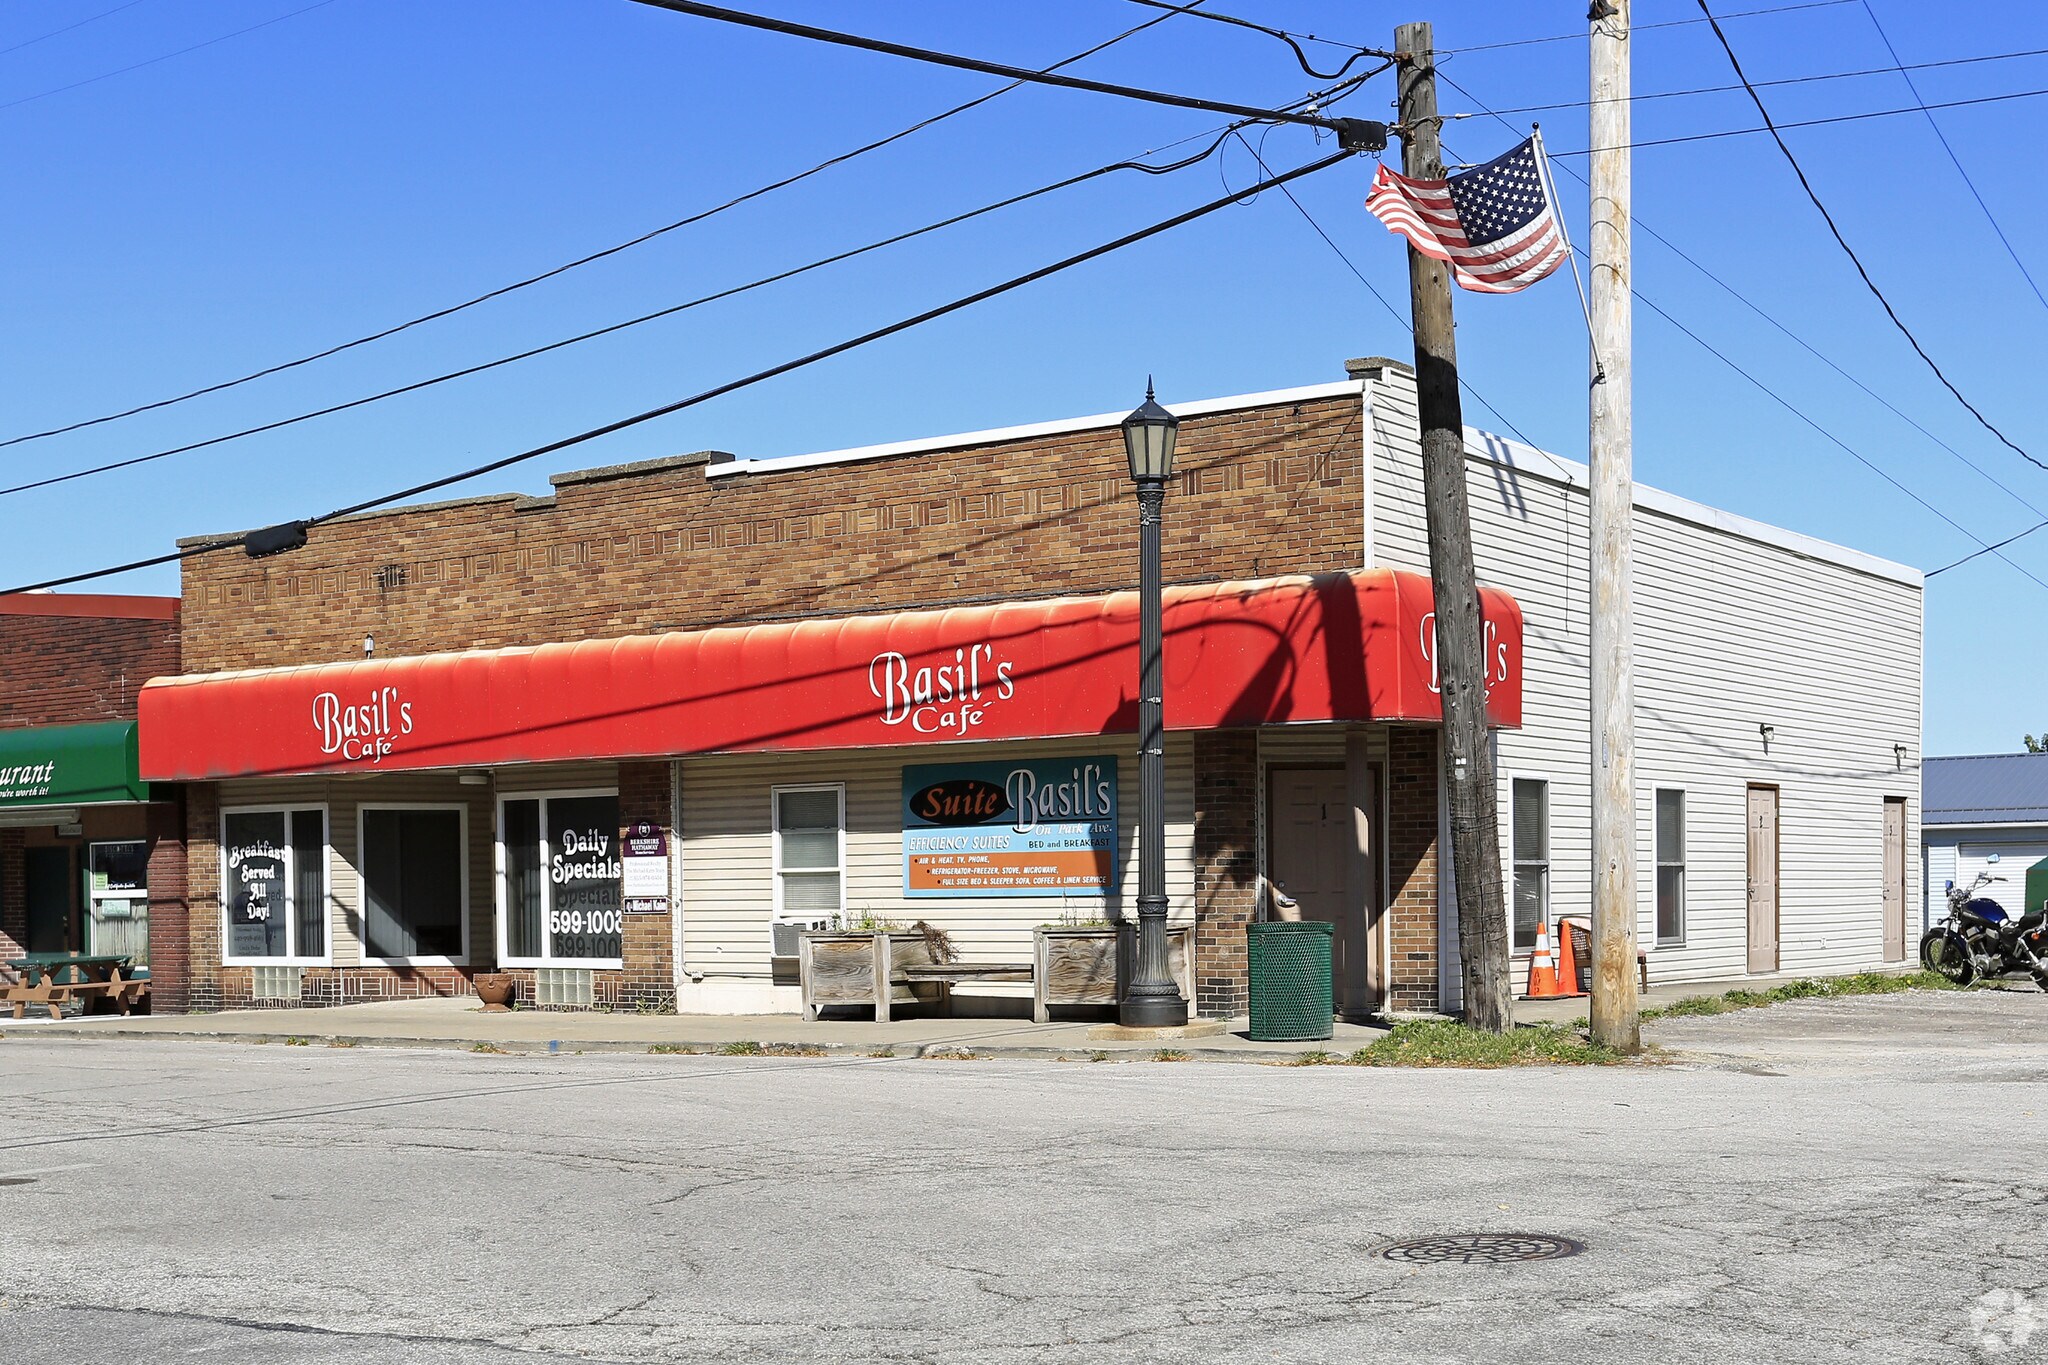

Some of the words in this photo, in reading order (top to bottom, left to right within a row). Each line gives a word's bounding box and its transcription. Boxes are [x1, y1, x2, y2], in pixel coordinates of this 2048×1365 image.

[869, 644, 1014, 725] Basil's
[312, 687, 413, 754] Basil's
[912, 701, 993, 736] Café
[343, 735, 398, 764] Café
[0, 760, 55, 785] urant
[15, 786, 38, 797] worth
[39, 786, 50, 796] it!
[922, 782, 998, 817] Suite
[1005, 764, 1111, 833] Basil's
[1035, 825, 1052, 836] On
[1057, 823, 1084, 834] Park
[1090, 823, 1112, 833] Ave.
[229, 839, 286, 869] Breakfast
[563, 828, 609, 857] Daily
[909, 836, 968, 851] EFFICIENCY
[972, 835, 1010, 849] SUITES
[1028, 840, 1044, 849] BED
[1047, 840, 1061, 848] and
[1064, 838, 1110, 849] BREAKFAST
[241, 864, 275, 883] Served
[551, 853, 621, 885] Specials
[970, 878, 981, 886] BED
[990, 877, 1013, 885] SLEEPER
[1033, 876, 1054, 884] COFFEE
[1063, 876, 1080, 884] LINEN
[1082, 875, 1106, 884] SERVICE
[249, 882, 267, 901] All
[247, 902, 270, 921] Day!
